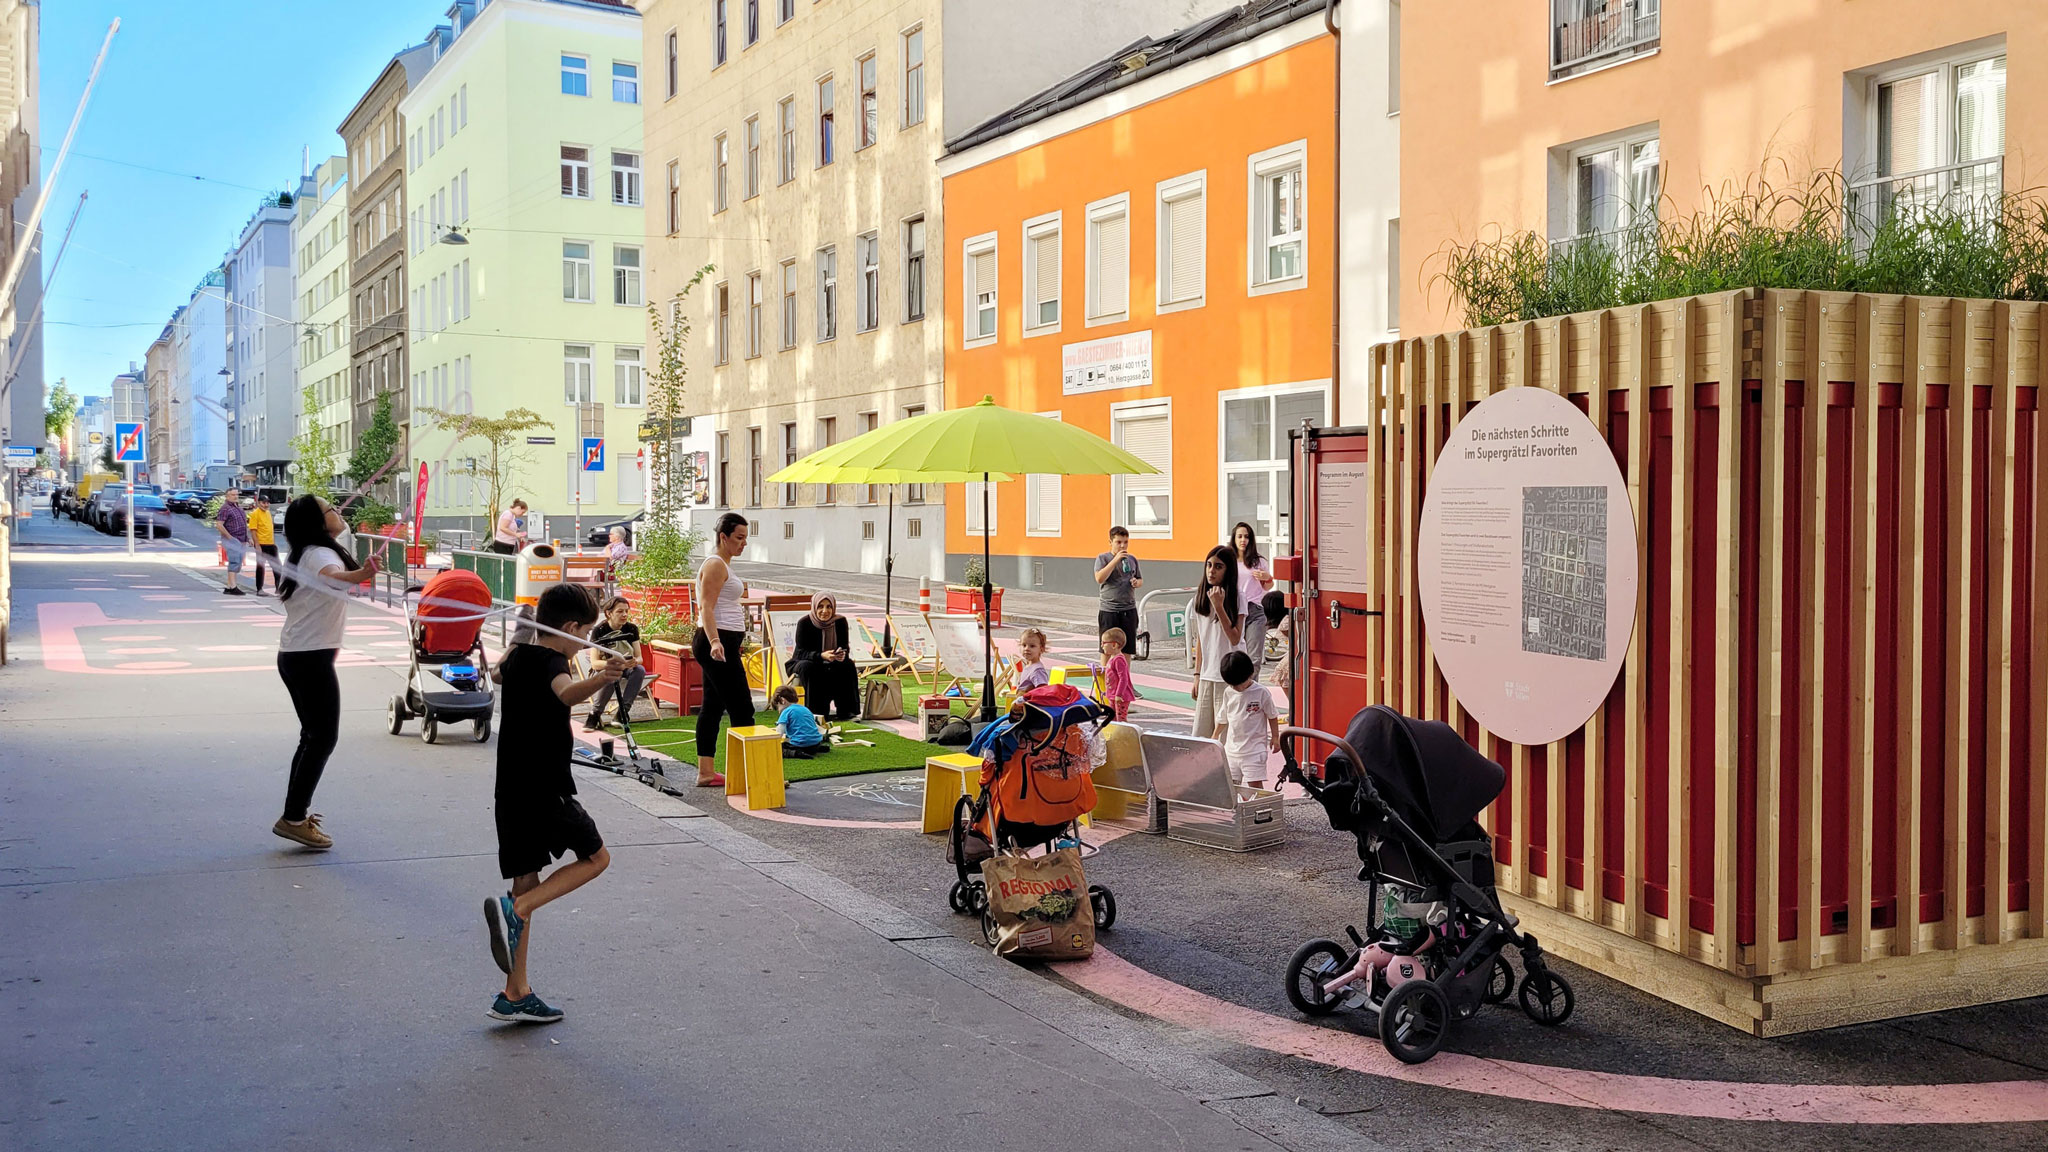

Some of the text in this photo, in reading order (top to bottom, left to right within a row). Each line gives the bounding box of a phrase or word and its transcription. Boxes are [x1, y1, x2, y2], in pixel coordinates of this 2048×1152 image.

[1125, 361, 1134, 370] 400
[1116, 374, 1141, 383] Herzgasse
[1142, 370, 1150, 379] 20
[1471, 424, 1569, 441] Die nächsten Schritte
[1464, 443, 1577, 462] im Supergrätzl Favoriten
[1320, 471, 1341, 479] Programm
[1349, 471, 1364, 479] August
[1170, 613, 1185, 635] P
[999, 874, 1078, 899] REGIONAL
